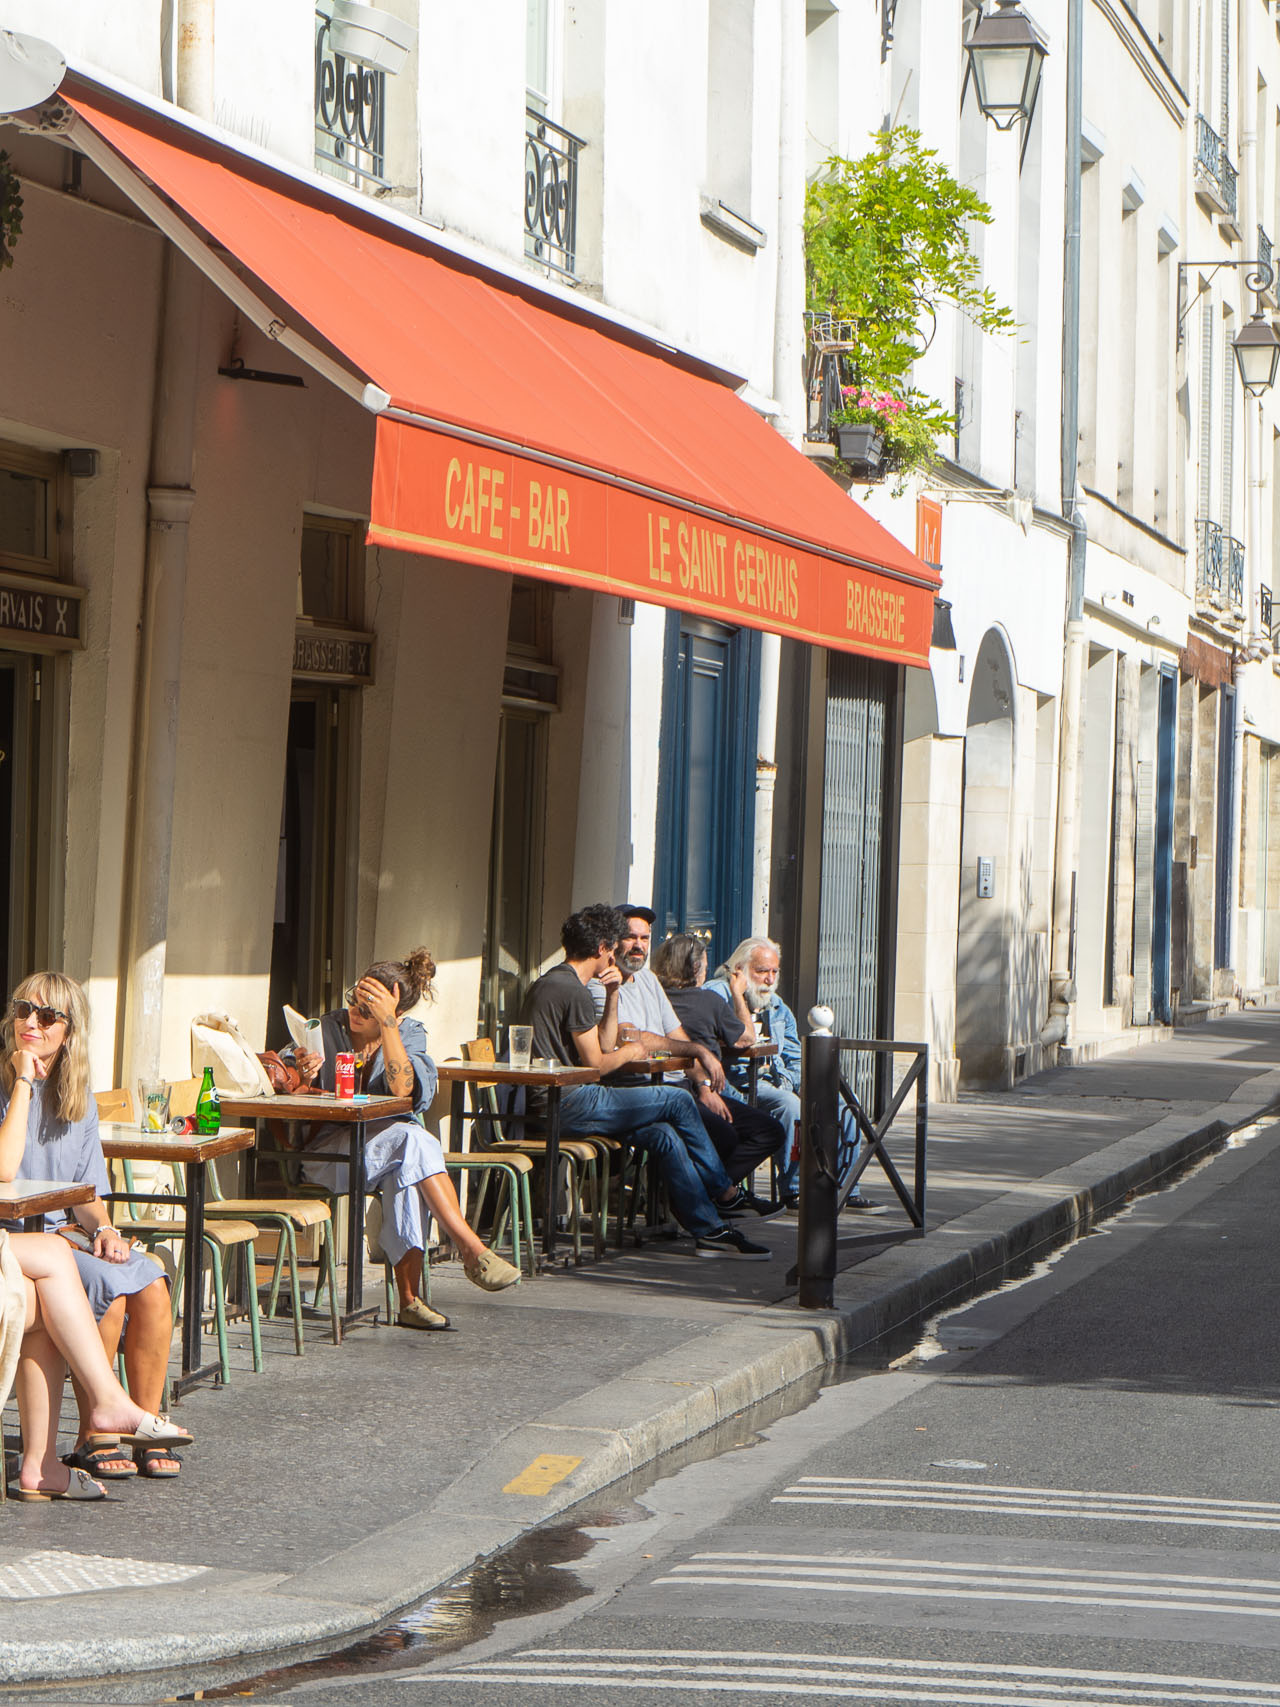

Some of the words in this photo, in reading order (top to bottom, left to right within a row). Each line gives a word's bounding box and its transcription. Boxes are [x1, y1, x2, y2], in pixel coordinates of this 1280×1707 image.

[445, 457, 505, 539] CAFE
[528, 480, 571, 555] BAR
[648, 512, 672, 584] LE
[677, 521, 728, 598] SAINT
[734, 539, 799, 620] GERVAIS
[846, 579, 905, 643] BRASSERIE
